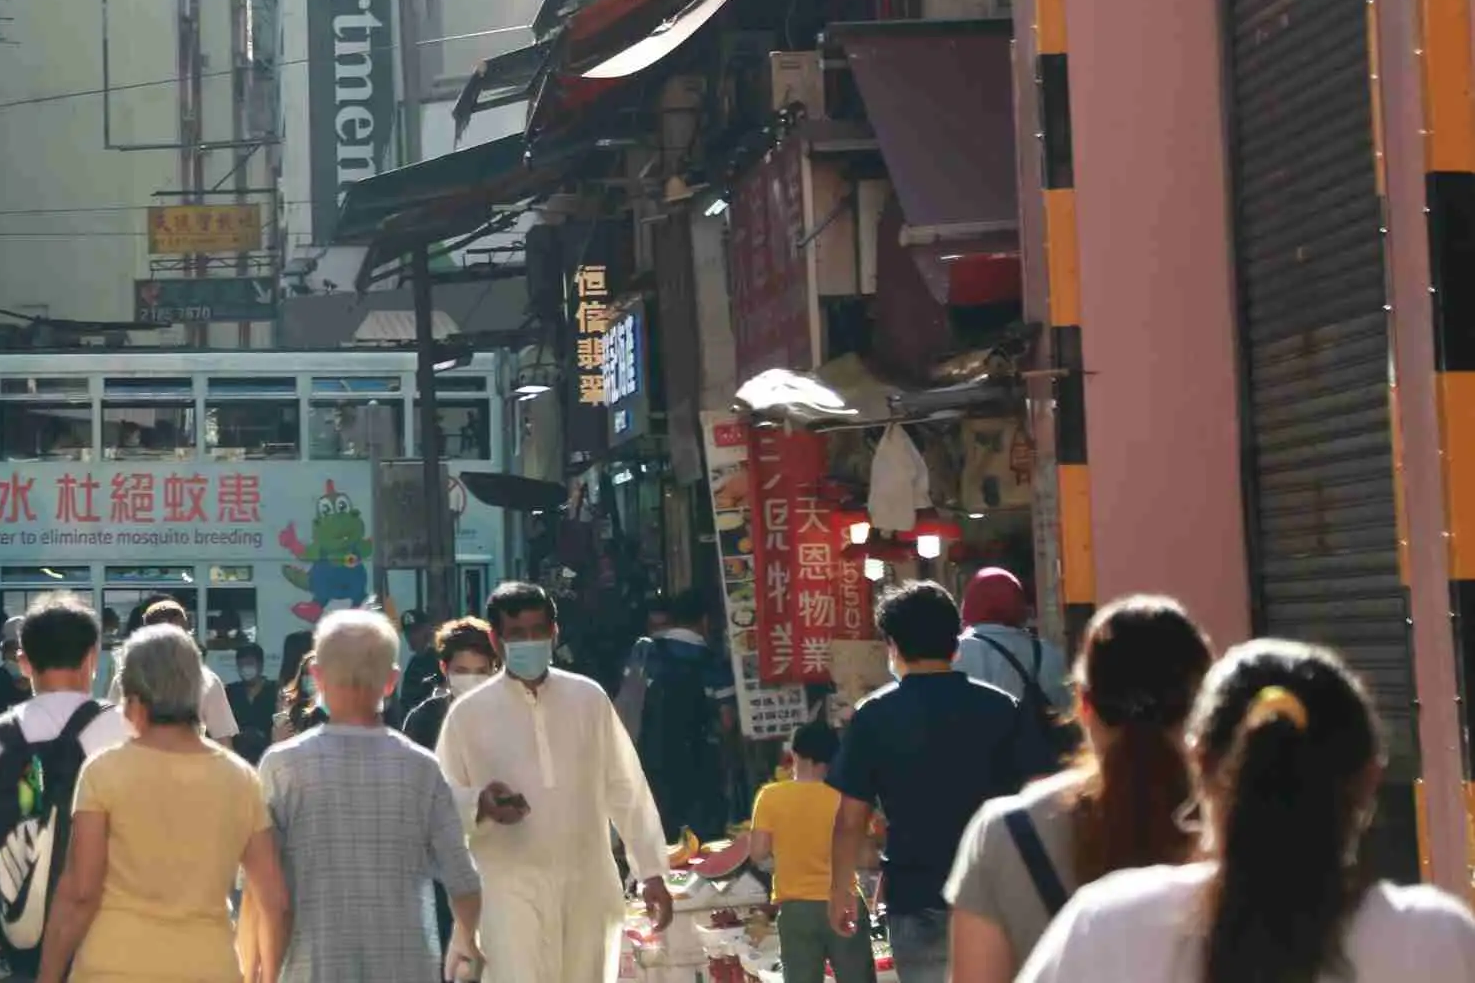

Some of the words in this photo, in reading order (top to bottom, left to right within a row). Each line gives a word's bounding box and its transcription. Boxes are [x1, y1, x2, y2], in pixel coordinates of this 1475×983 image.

[56, 473, 262, 524] 杜絕蚊患
[20, 530, 36, 545] to
[40, 528, 113, 545] eliminate
[117, 529, 190, 548] mosquito
[194, 529, 263, 549] breeding
[795, 495, 836, 673] 天恩物業
